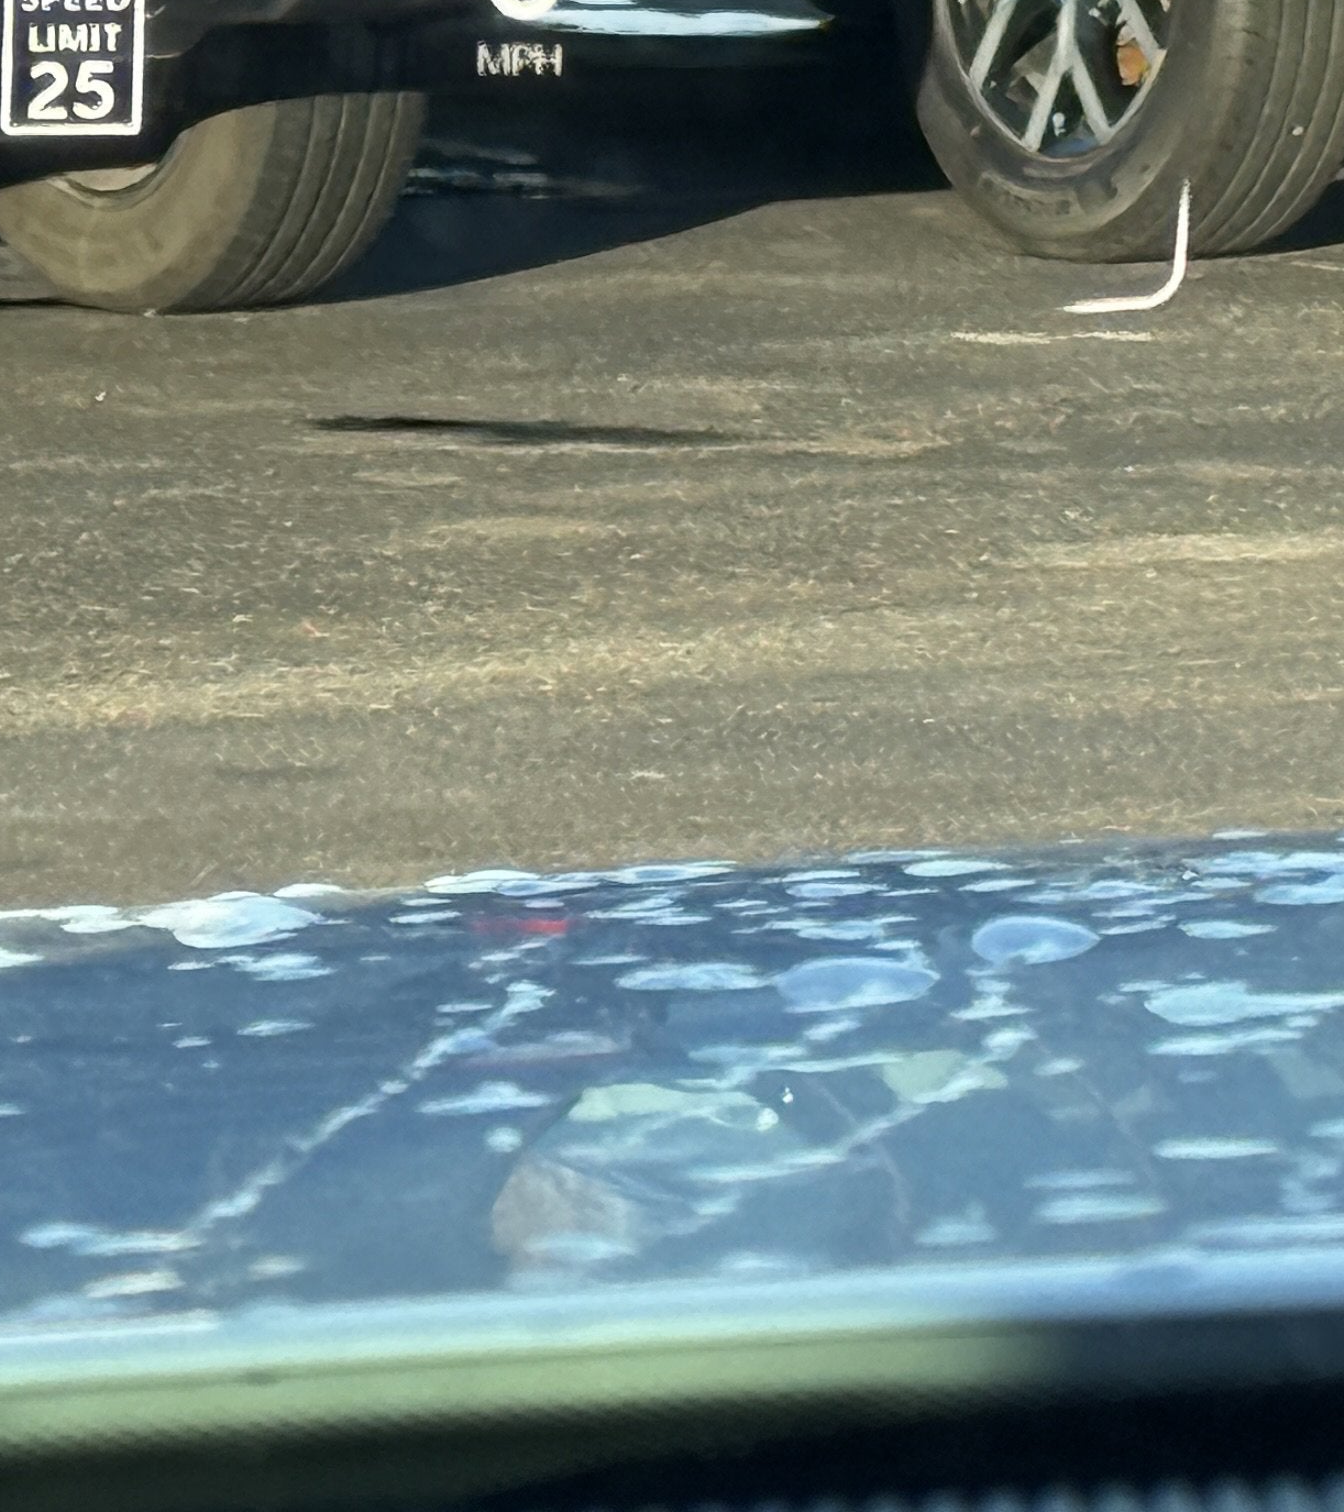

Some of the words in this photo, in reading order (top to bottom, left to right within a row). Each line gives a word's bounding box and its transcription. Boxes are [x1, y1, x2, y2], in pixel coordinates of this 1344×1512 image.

[28, 22, 122, 52] LIMIT
[477, 41, 564, 77] MPH
[27, 60, 115, 120] 25
